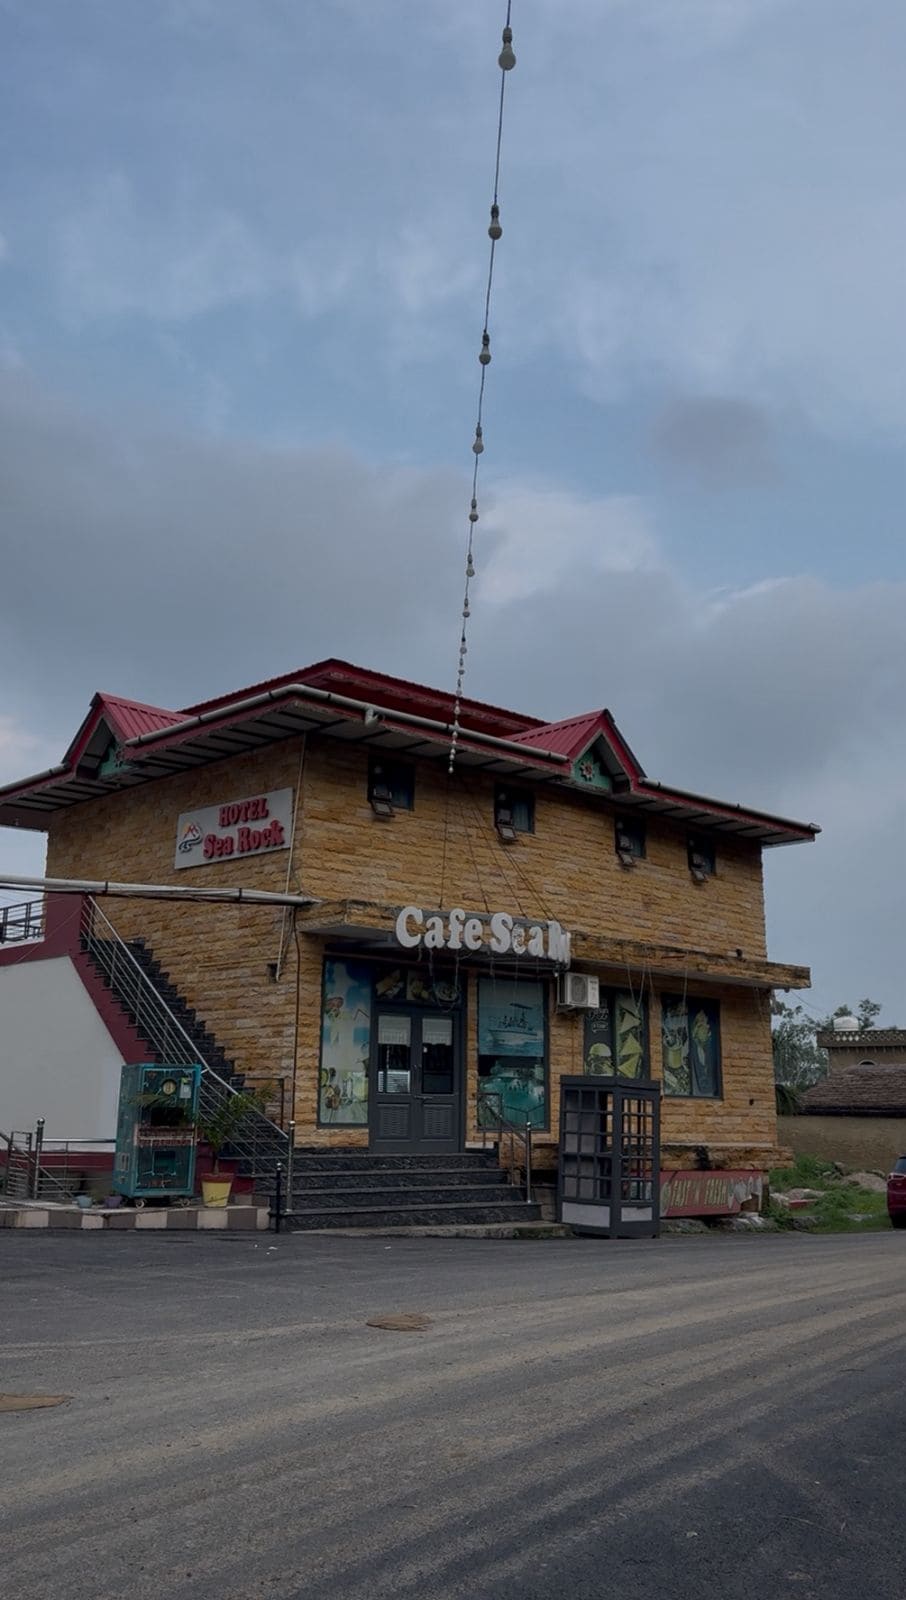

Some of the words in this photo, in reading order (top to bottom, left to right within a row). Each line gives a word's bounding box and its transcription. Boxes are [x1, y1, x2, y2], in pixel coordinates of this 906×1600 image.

[219, 798, 269, 827] HOTEL
[203, 834, 234, 859] Sea
[238, 819, 284, 852] Rock
[395, 906, 484, 950] Cafe
